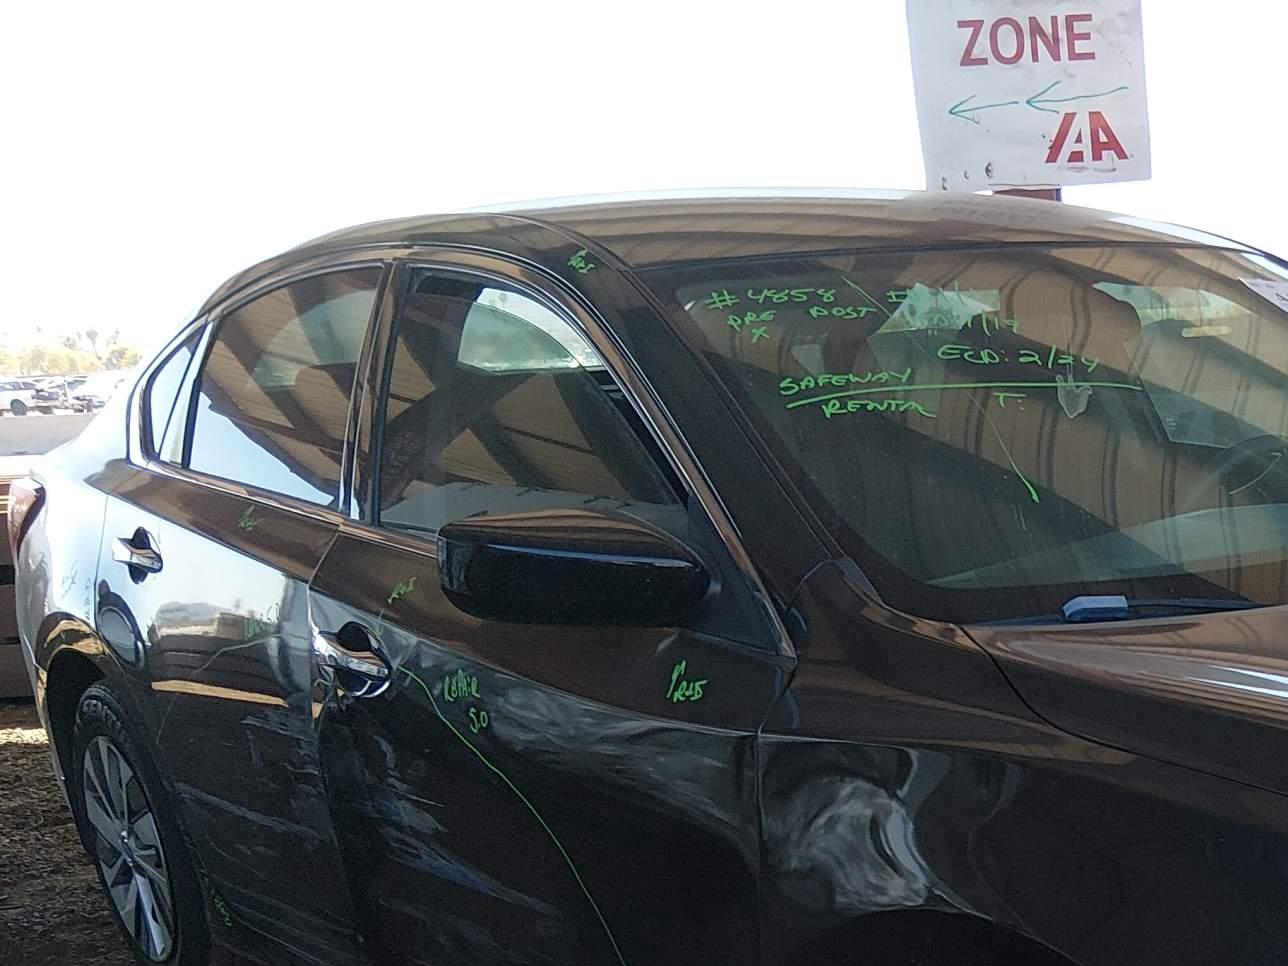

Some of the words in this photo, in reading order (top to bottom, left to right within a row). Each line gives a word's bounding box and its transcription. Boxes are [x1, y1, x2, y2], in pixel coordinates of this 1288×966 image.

[957, 13, 1096, 67] ZONE
[747, 288, 836, 305] 4858
[808, 305, 878, 319] POST
[779, 367, 912, 396] SAFEWAY
